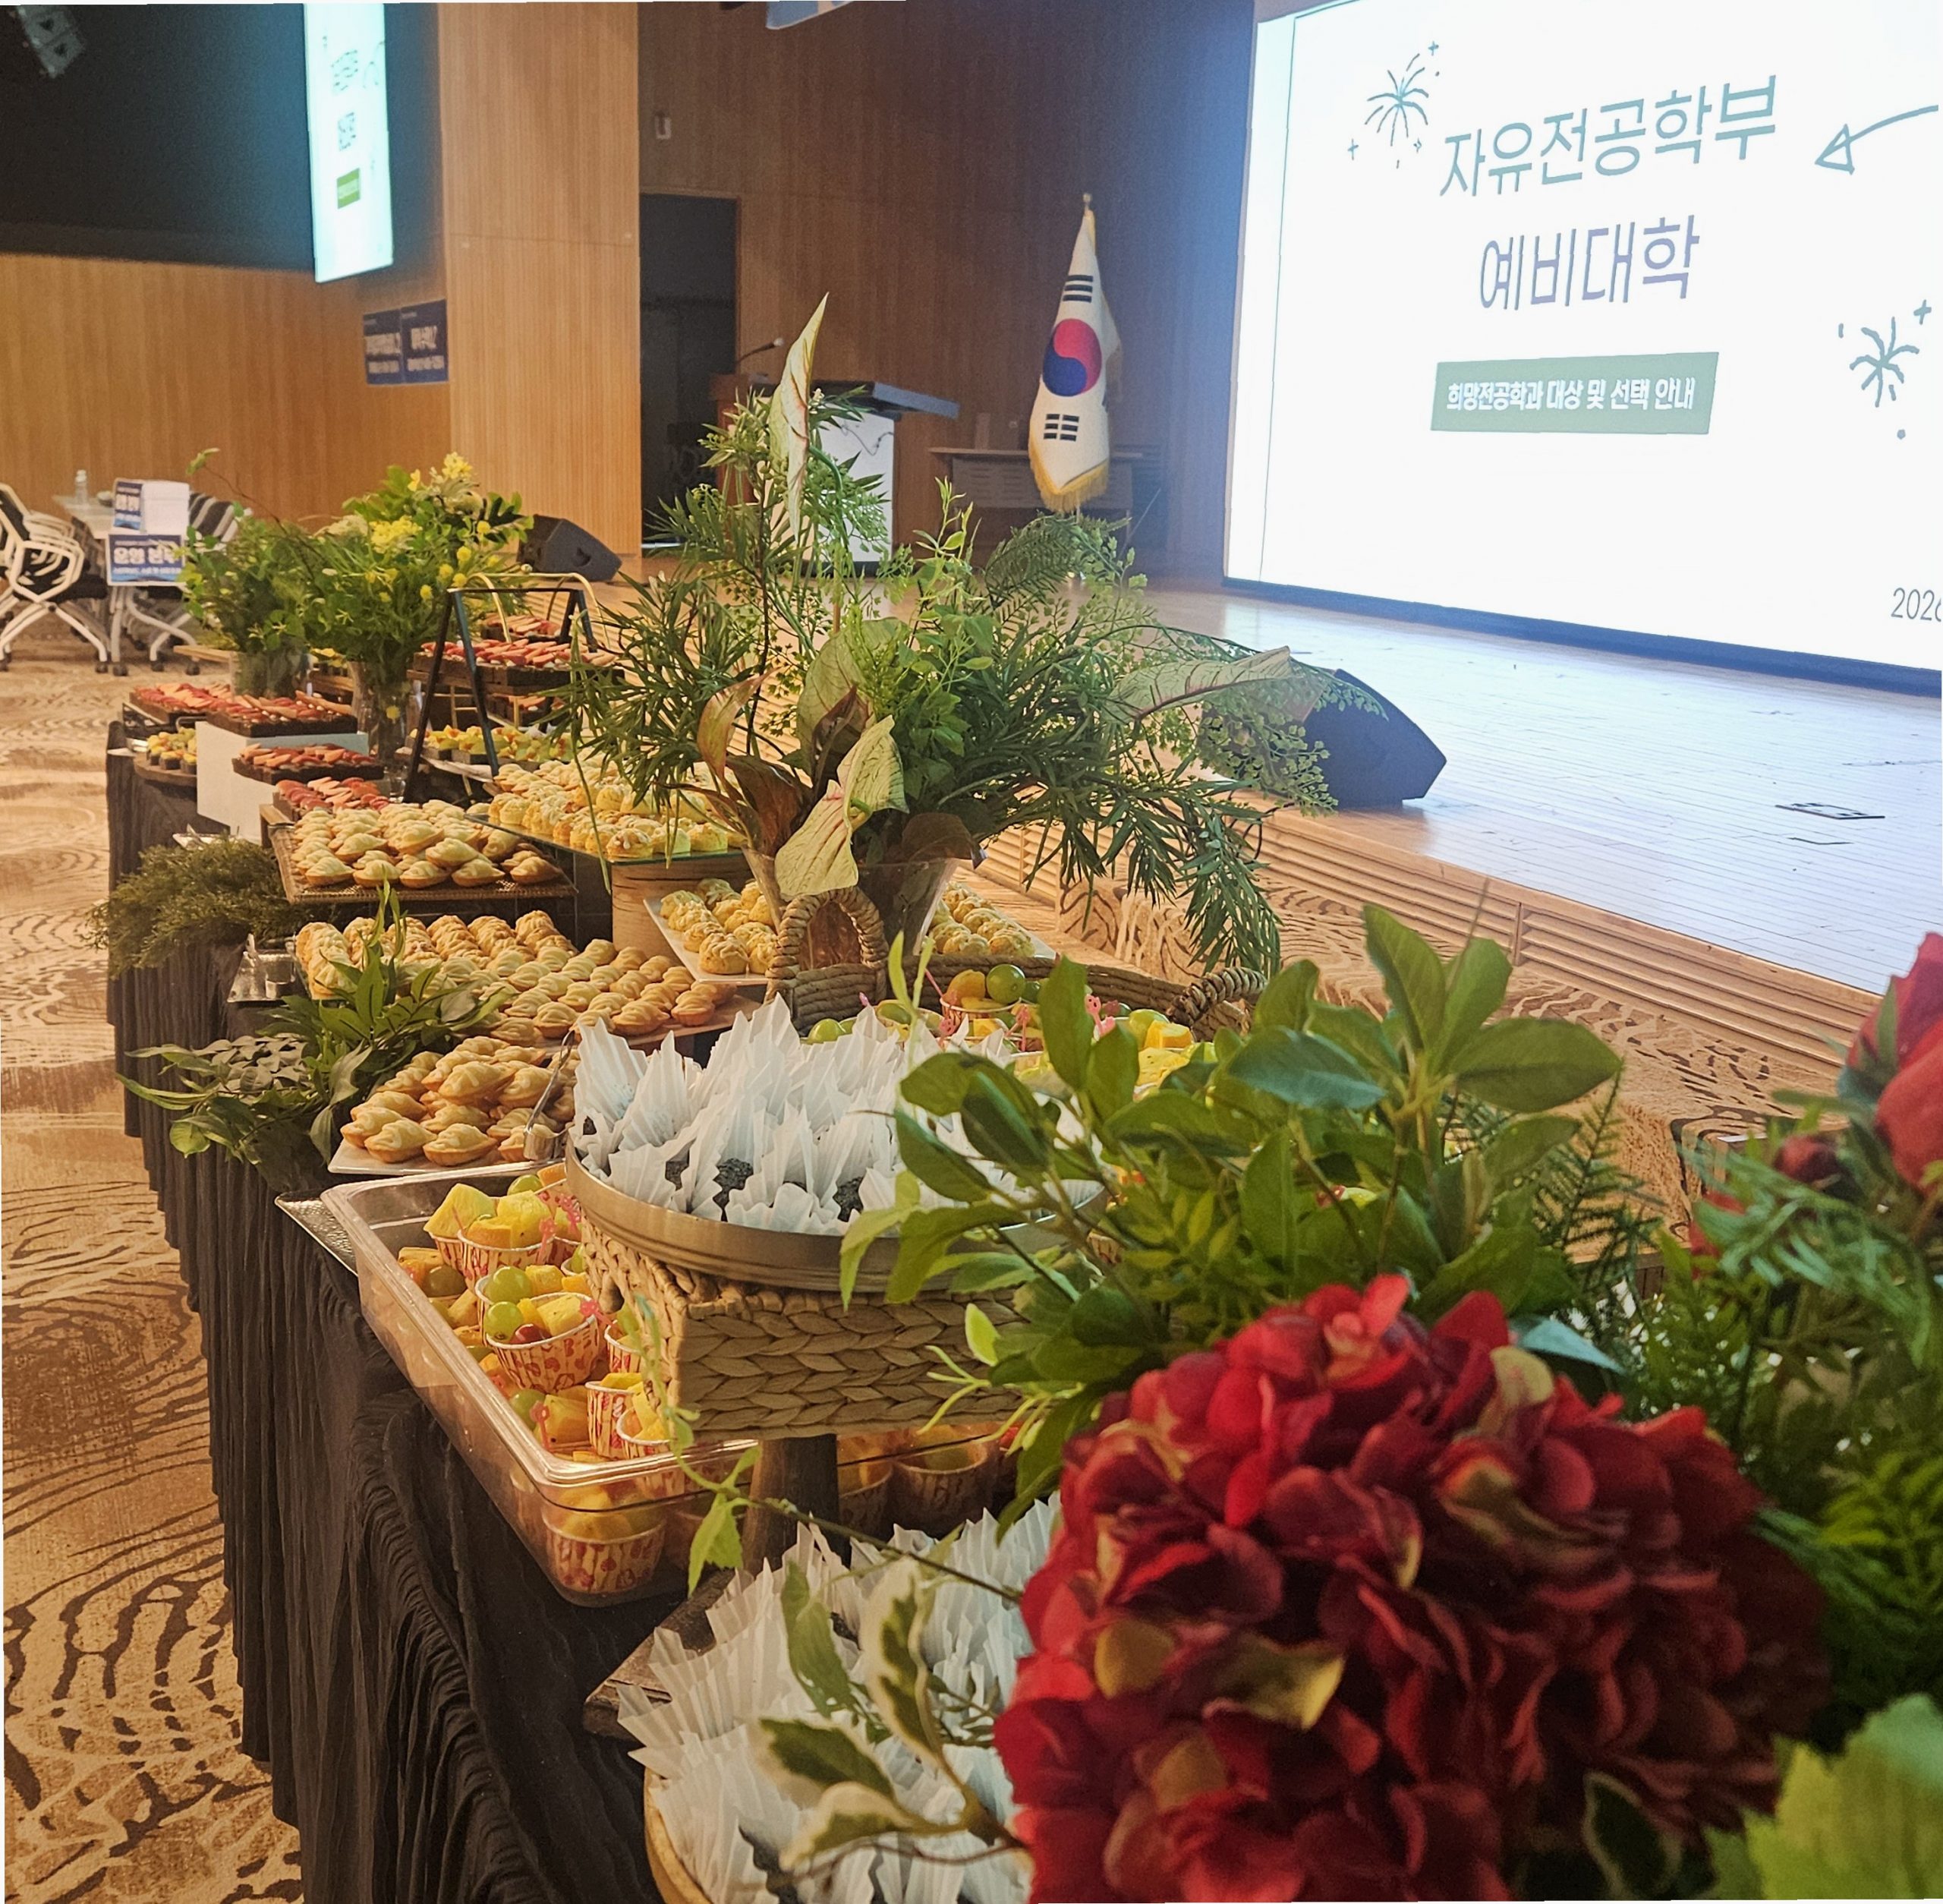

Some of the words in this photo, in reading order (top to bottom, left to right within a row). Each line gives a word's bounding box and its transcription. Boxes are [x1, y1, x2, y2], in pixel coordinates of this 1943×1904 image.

[1440, 74, 1776, 197] 자유전공학부
[1480, 215, 1700, 311] 예비대학
[1447, 381, 1544, 411] 희망전공학과
[1546, 380, 1584, 410] 대상
[1586, 378, 1607, 411] 및
[1611, 378, 1650, 411] 선택
[1655, 377, 1696, 411] 안내
